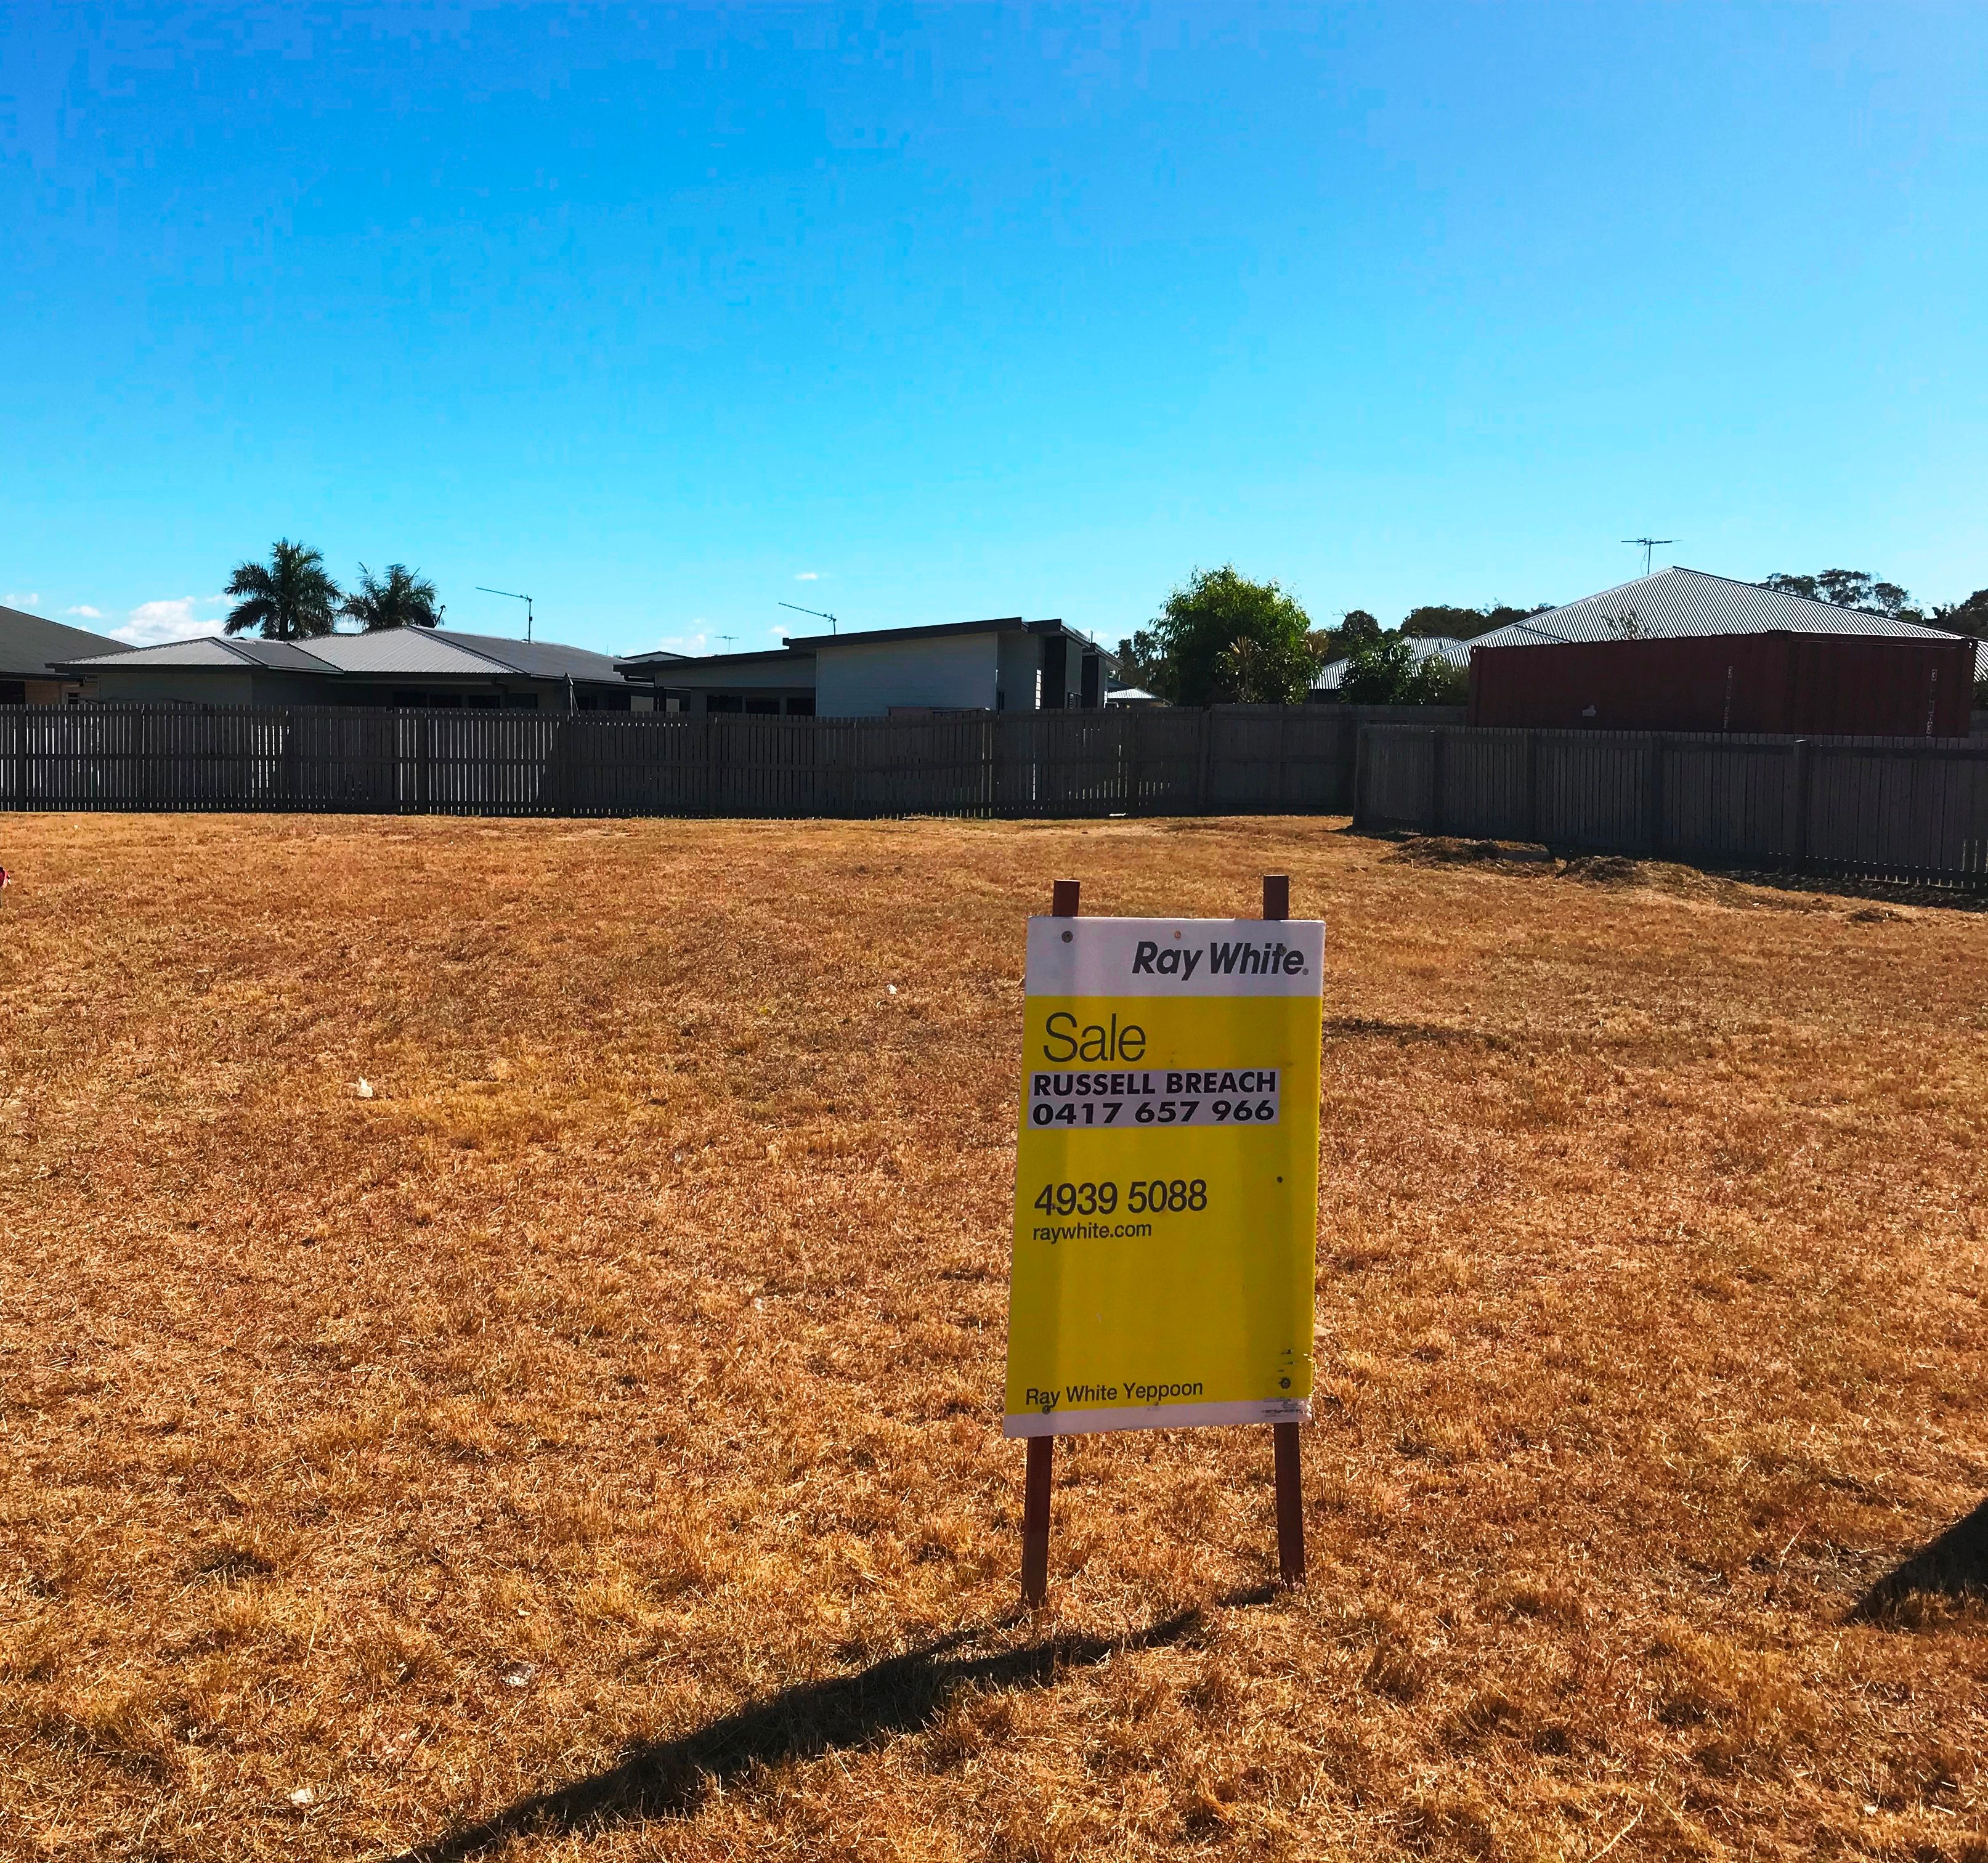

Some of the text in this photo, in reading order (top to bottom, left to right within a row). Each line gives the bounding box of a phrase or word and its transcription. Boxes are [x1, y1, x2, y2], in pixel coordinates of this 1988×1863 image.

[1132, 941, 1304, 980] Ray White
[1043, 1012, 1146, 1062] Sale
[1034, 1071, 1276, 1096] RUSSELL BREACH
[1033, 1100, 1275, 1126] 0417 657 966
[1034, 1179, 1207, 1216] 4939 5088
[1033, 1222, 1152, 1244] raywhite.com
[1026, 1381, 1204, 1408] Ray White Yeppoon
